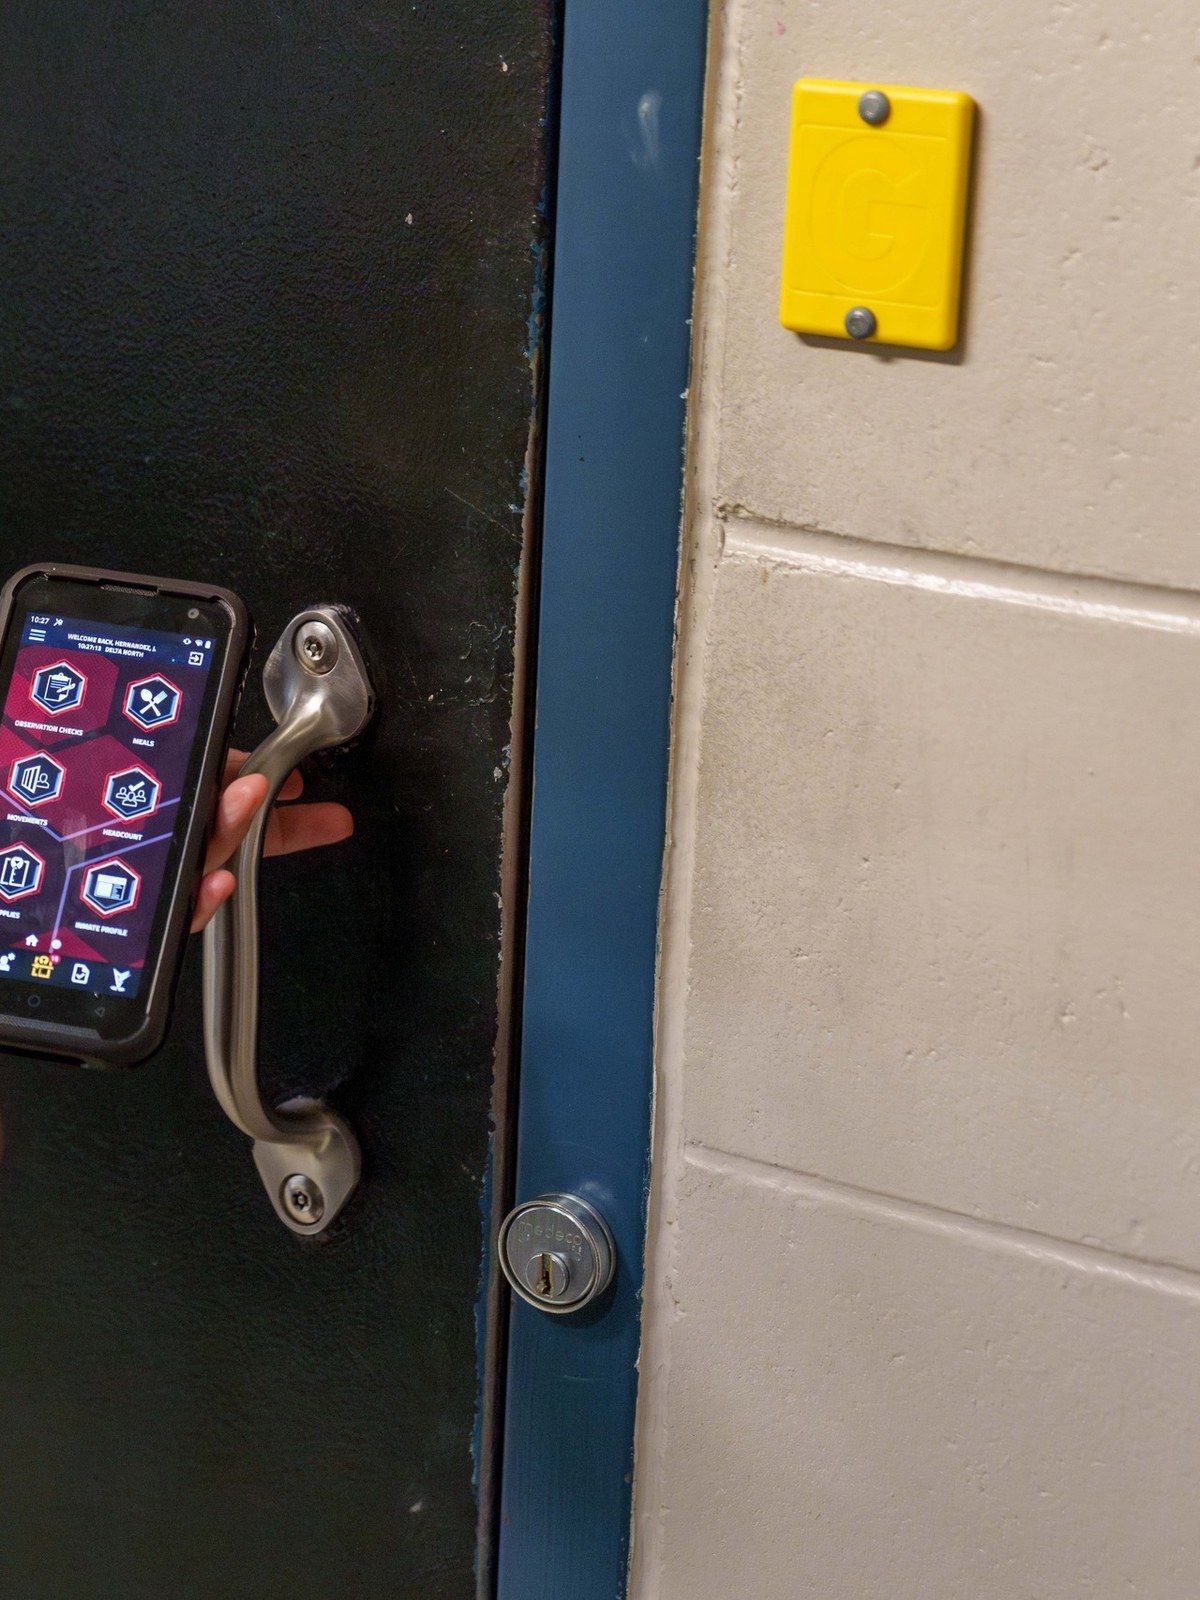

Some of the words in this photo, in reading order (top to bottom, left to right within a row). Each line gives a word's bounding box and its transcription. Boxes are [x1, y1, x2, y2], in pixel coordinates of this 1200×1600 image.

[811, 136, 931, 294] G
[30, 615, 50, 625] 10:27
[67, 633, 97, 644] WELCOME
[97, 637, 114, 646] BACK,
[104, 647, 122, 655] DELTA
[123, 650, 144, 658] NORTH
[14, 719, 57, 733] OBSERVATION
[58, 726, 84, 736] CHECKS
[132, 737, 155, 747] MEALS
[6, 813, 48, 826] MOVEMENTS
[102, 828, 143, 841] HEADCOUNT
[74, 921, 100, 932] INMATE
[101, 925, 129, 937] PROFILE
